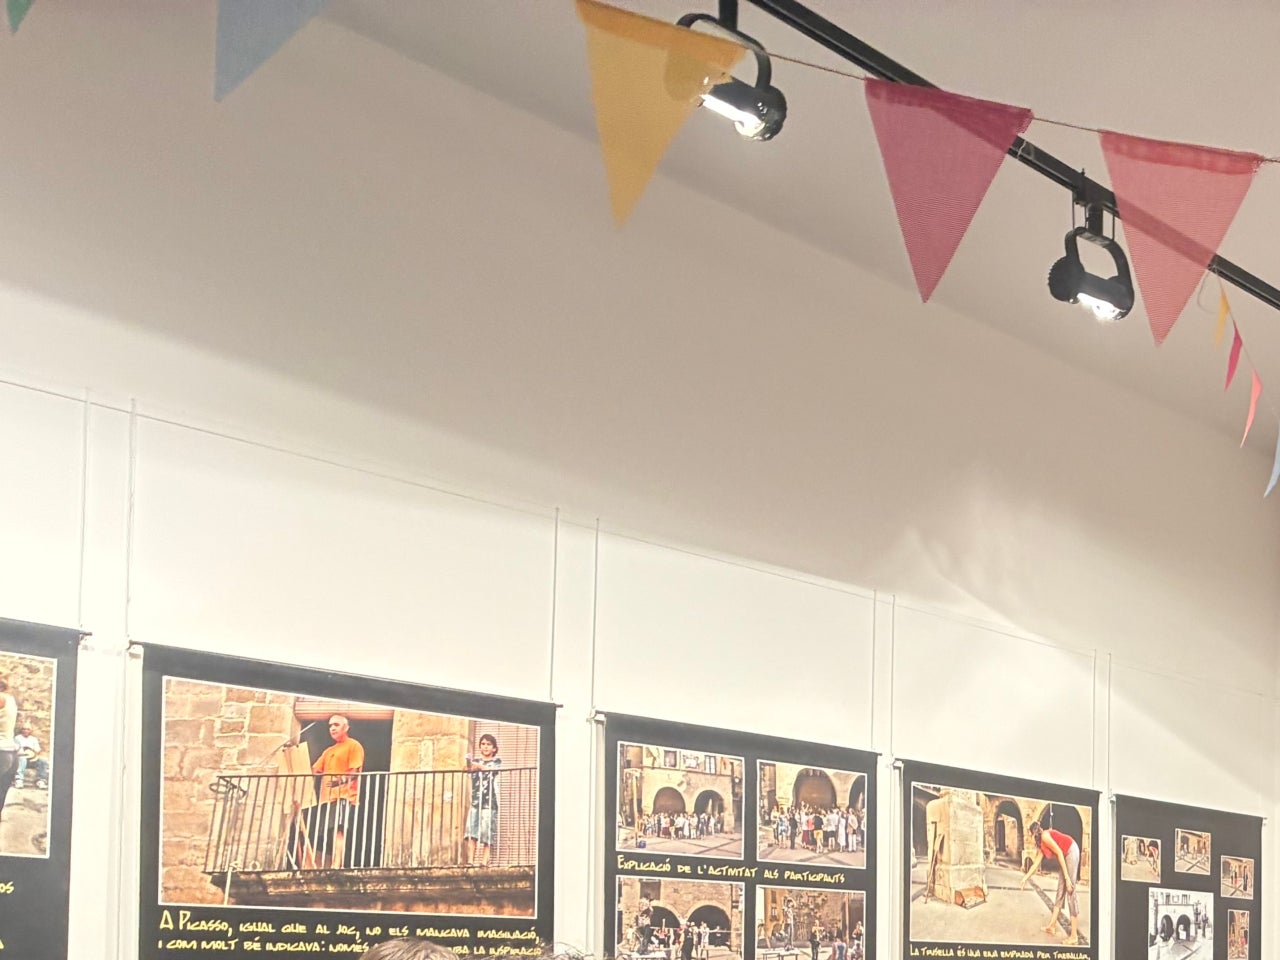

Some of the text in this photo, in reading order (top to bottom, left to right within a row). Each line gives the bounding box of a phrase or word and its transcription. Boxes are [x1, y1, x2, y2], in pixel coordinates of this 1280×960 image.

[159, 909, 174, 931] A
[240, 921, 276, 934] IGUAL
[282, 920, 307, 934] QUE
[316, 922, 331, 934] AL
[366, 925, 382, 936] NO
[389, 925, 410, 937] ELS
[416, 926, 470, 939] MANCAVA
[166, 939, 198, 952] COM
[201, 938, 237, 951] MOLT
